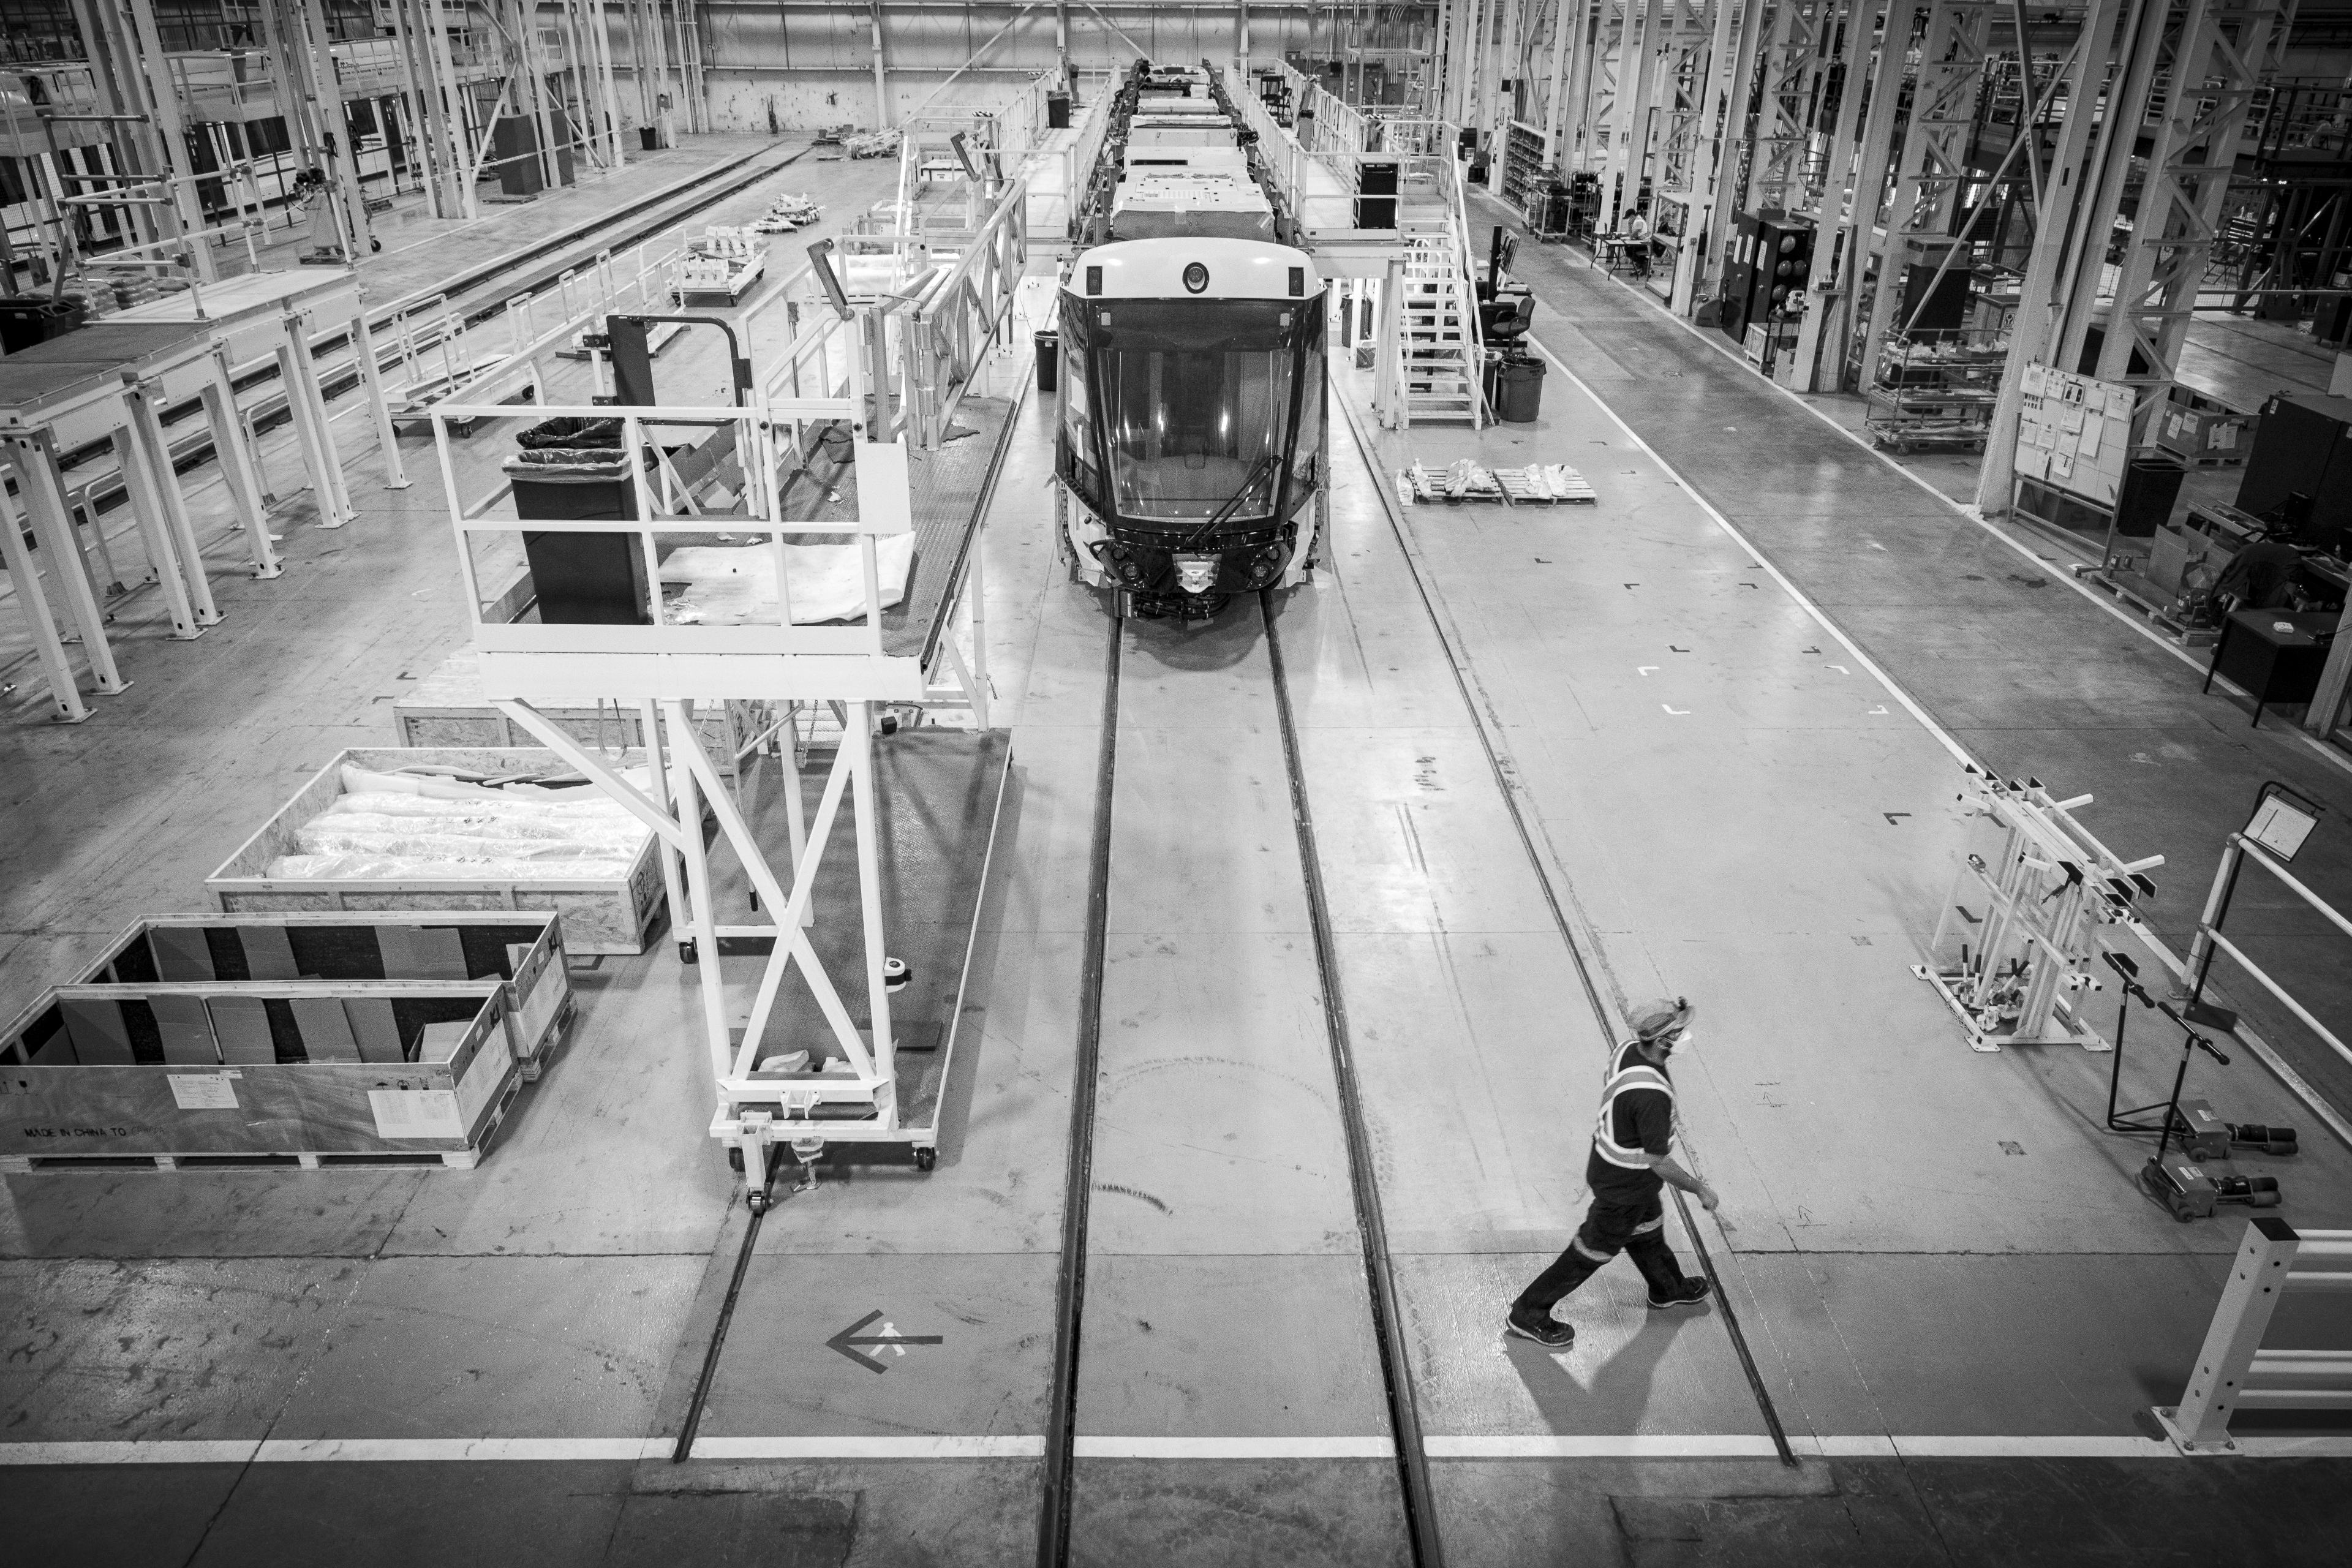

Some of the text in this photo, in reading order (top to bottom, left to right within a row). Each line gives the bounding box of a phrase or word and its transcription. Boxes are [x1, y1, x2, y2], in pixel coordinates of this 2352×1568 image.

[23, 1128, 57, 1137] MADE
[59, 1128, 71, 1137] IN
[74, 1128, 107, 1137] CHINA
[110, 1127, 126, 1136] TO
